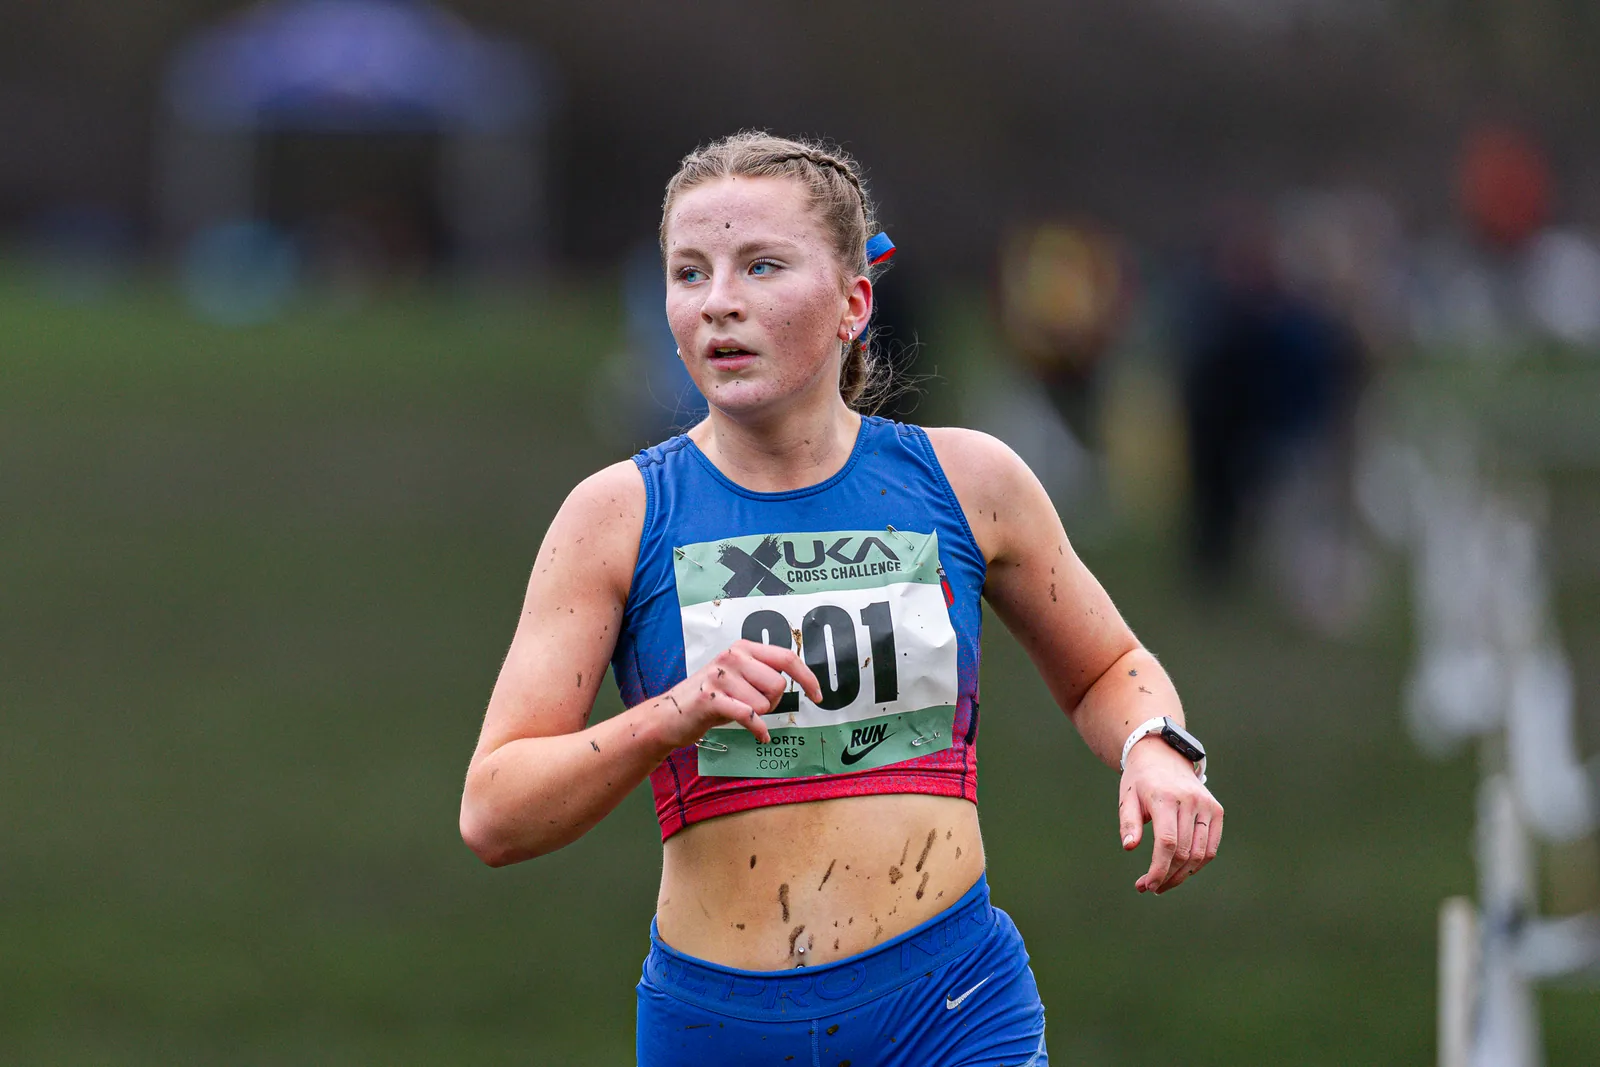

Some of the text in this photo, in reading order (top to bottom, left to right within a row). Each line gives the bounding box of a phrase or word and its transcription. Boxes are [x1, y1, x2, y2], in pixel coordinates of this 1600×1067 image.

[782, 536, 900, 569] UKA
[787, 561, 902, 583] CROSS CHALLENGE
[755, 735, 806, 746] ORTS
[850, 722, 889, 749] RUN
[755, 746, 799, 758] SHOES
[756, 759, 790, 770] .COM
